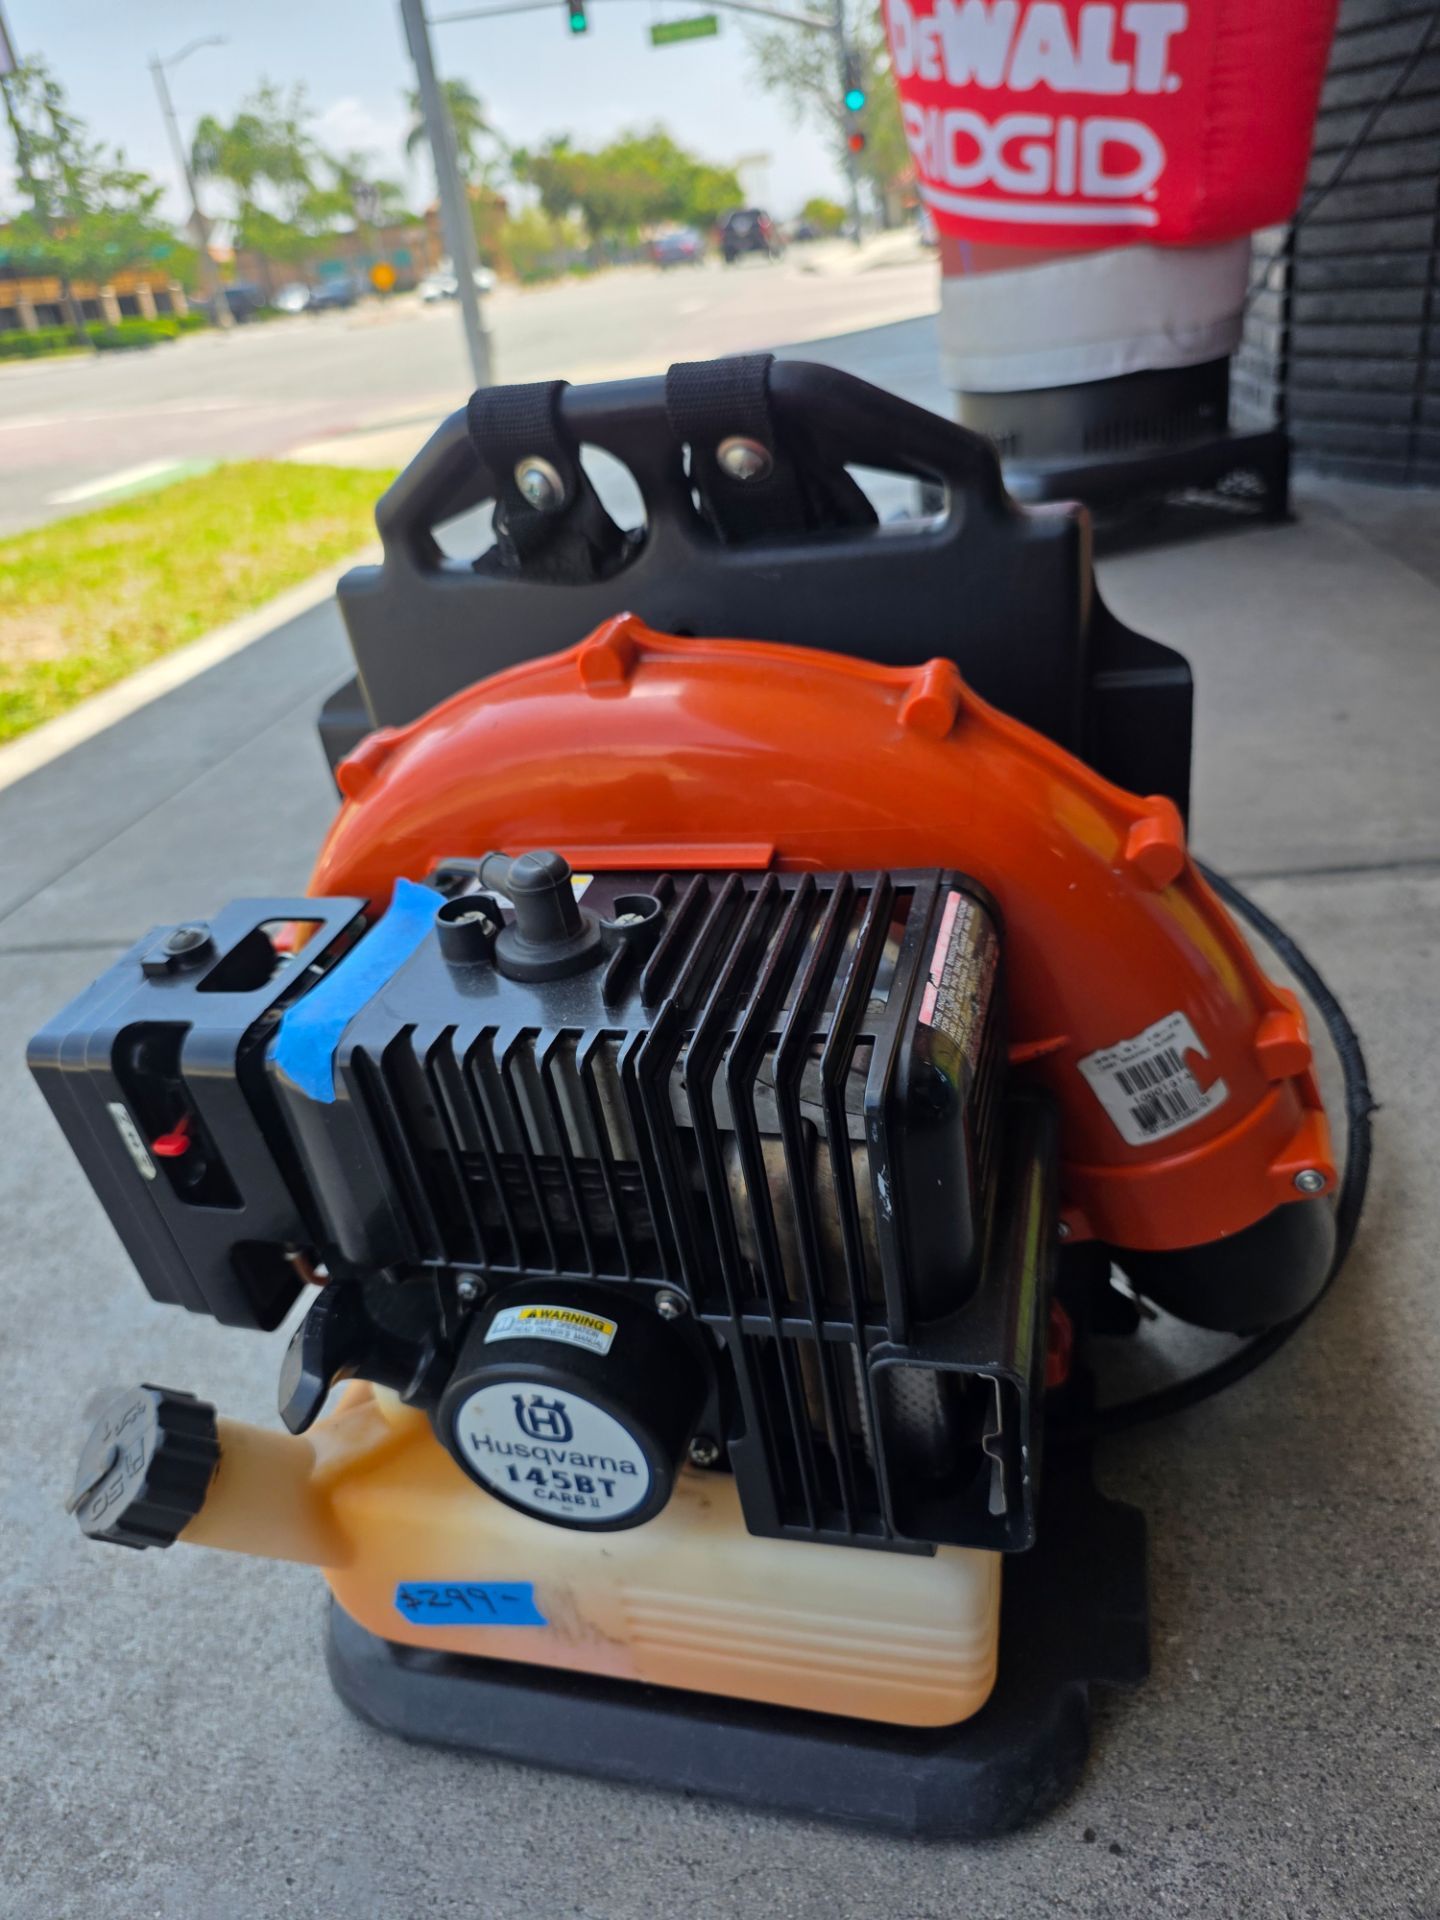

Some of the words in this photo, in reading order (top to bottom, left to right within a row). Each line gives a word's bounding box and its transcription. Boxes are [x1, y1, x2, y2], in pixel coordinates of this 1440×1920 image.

[901, 99, 1165, 198] RIDGID
[540, 1308, 605, 1332] WARNING
[471, 1432, 639, 1476] Husqvarna
[505, 1463, 617, 1498] 145BT
[533, 1487, 586, 1506] CARB
